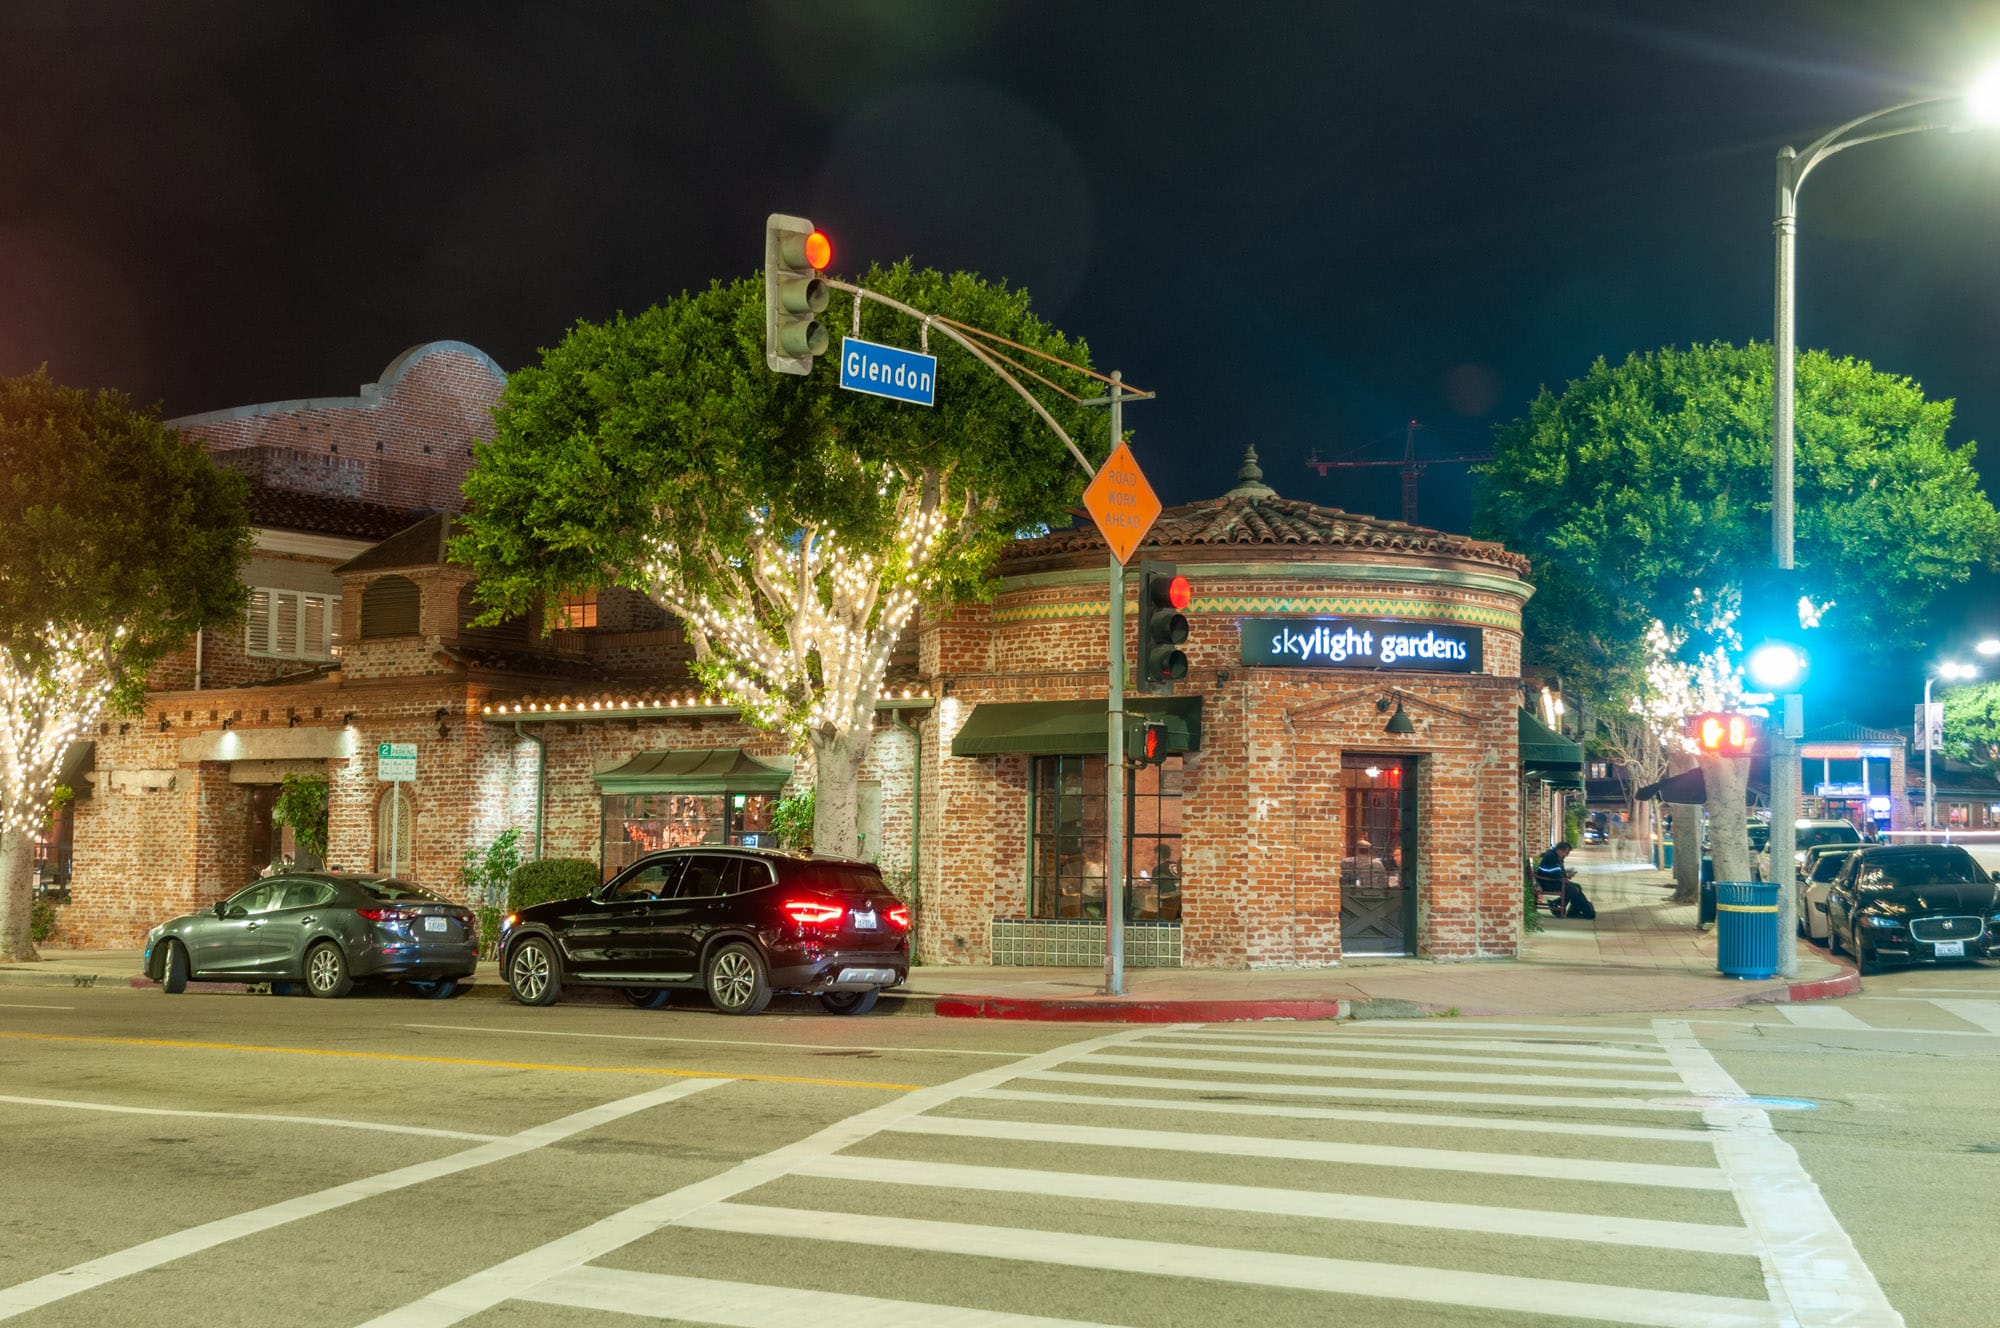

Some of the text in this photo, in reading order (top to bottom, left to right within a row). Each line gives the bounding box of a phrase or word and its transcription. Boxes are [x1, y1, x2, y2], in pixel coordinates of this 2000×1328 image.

[847, 351, 931, 393] Glendon
[1108, 470, 1137, 488] ROAD
[1108, 491, 1137, 508] WORK
[1105, 512, 1141, 530] AHEAD
[1271, 626, 1467, 663] skylight gardens
[381, 745, 390, 755] 2
